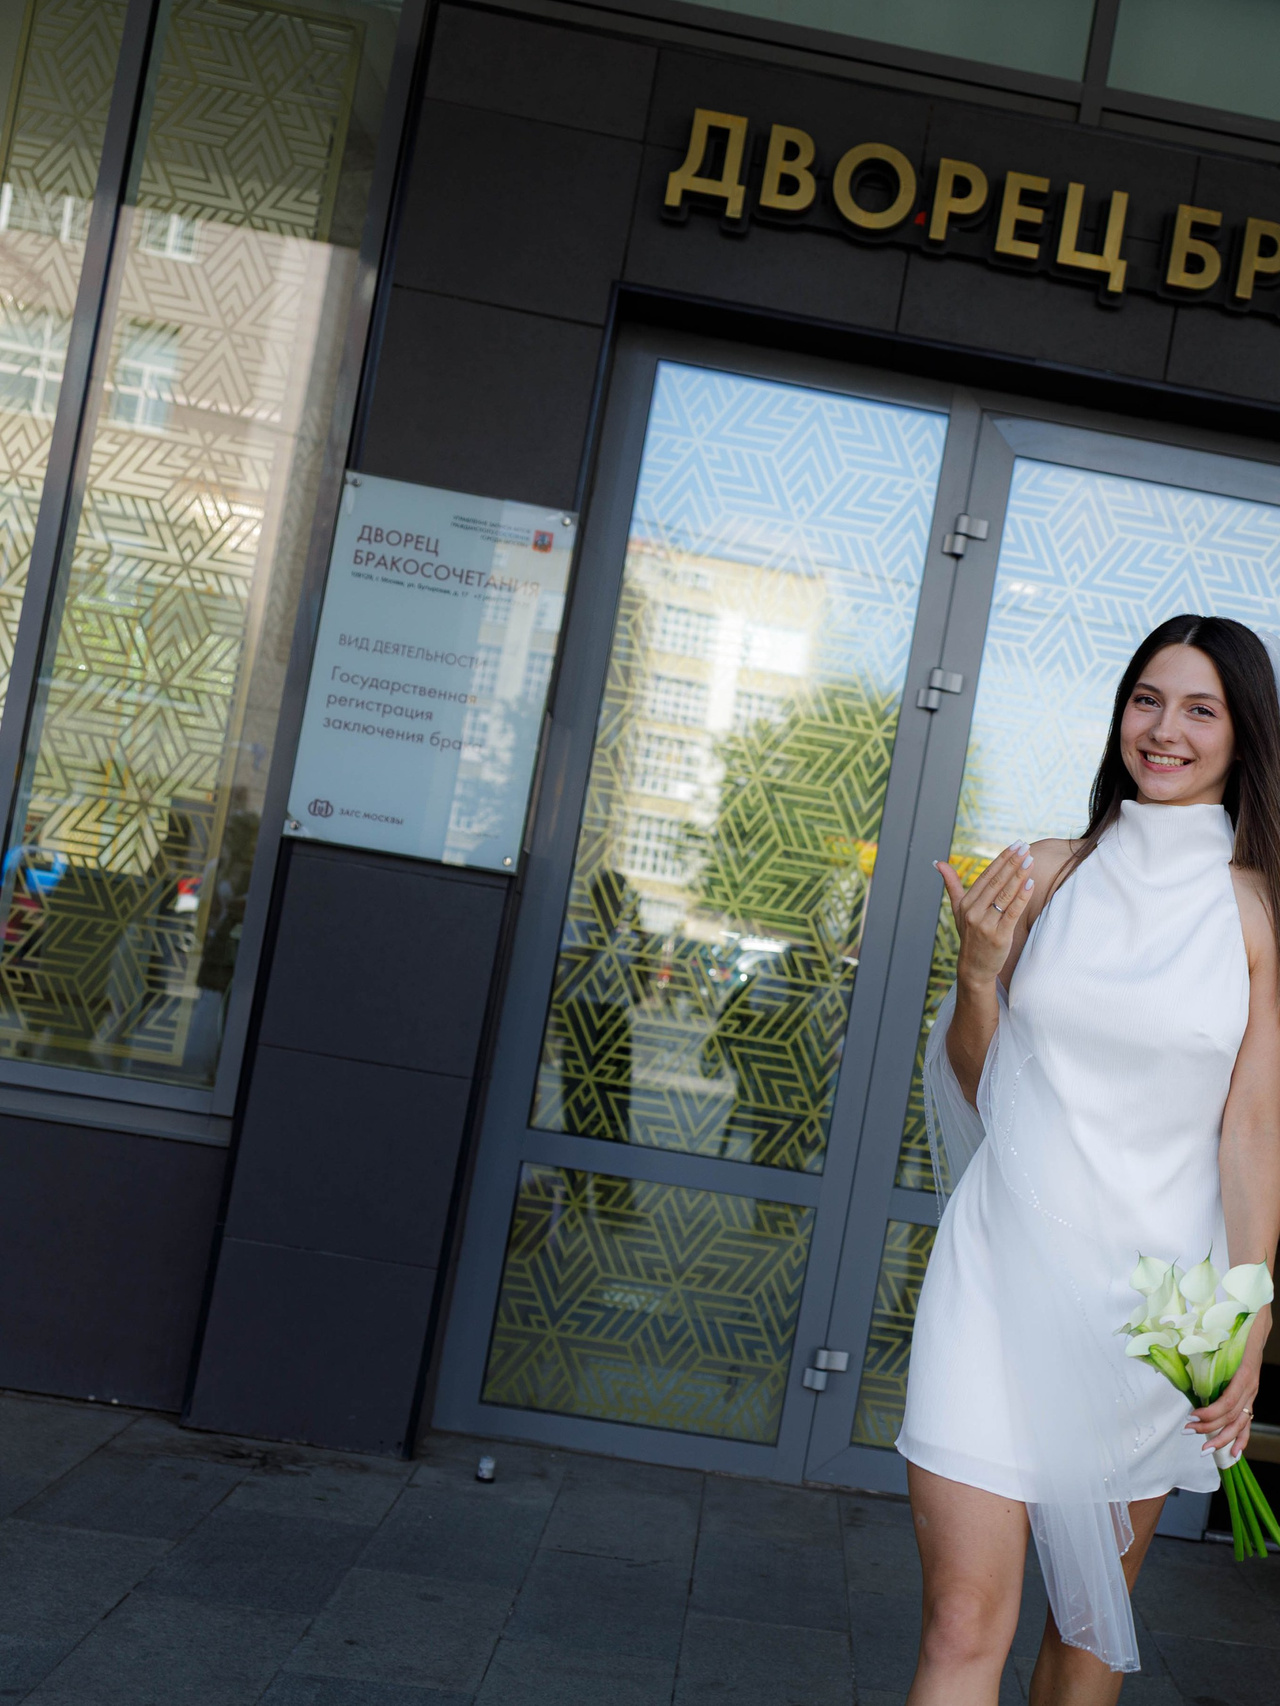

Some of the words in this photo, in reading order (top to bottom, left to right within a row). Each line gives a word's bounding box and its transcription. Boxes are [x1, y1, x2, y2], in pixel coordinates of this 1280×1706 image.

[664, 108, 1129, 294] ДВОРЕЦ
[357, 525, 440, 557] ДВОРЕЦ
[352, 549, 540, 598] БРАКОСОЧЕТАНИЯ
[338, 633, 371, 651] ВИД
[372, 640, 487, 670] ДЕЯТЕЛЬНОСТИ
[330, 666, 478, 706] Государственная
[326, 692, 434, 723] регистрация
[323, 716, 424, 745] заключения
[362, 811, 405, 825] МОСКВЫ
